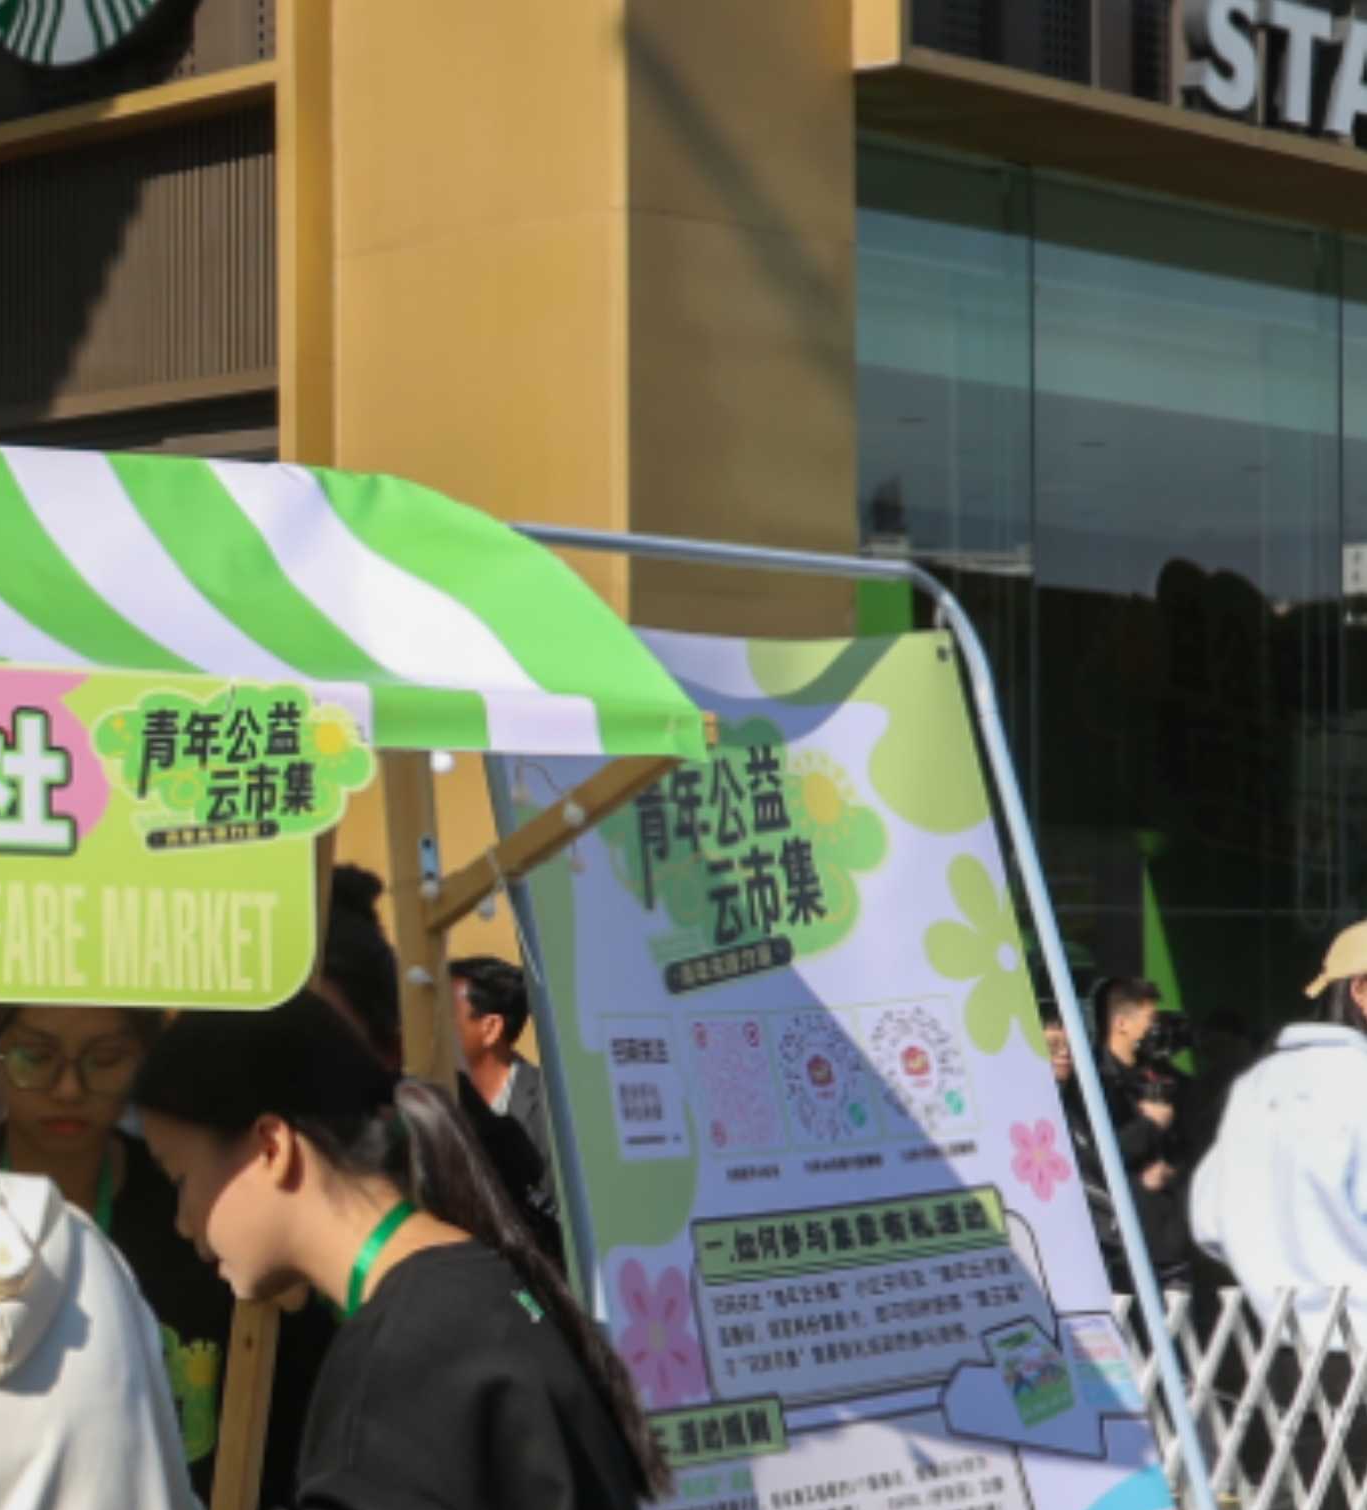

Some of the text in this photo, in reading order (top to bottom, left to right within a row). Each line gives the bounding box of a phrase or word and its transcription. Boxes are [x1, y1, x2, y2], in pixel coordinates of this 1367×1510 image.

[138, 701, 301, 798] 青年公益
[207, 761, 315, 821] 云市集
[102, 886, 279, 993] MARKET
[706, 834, 827, 944] 云市集
